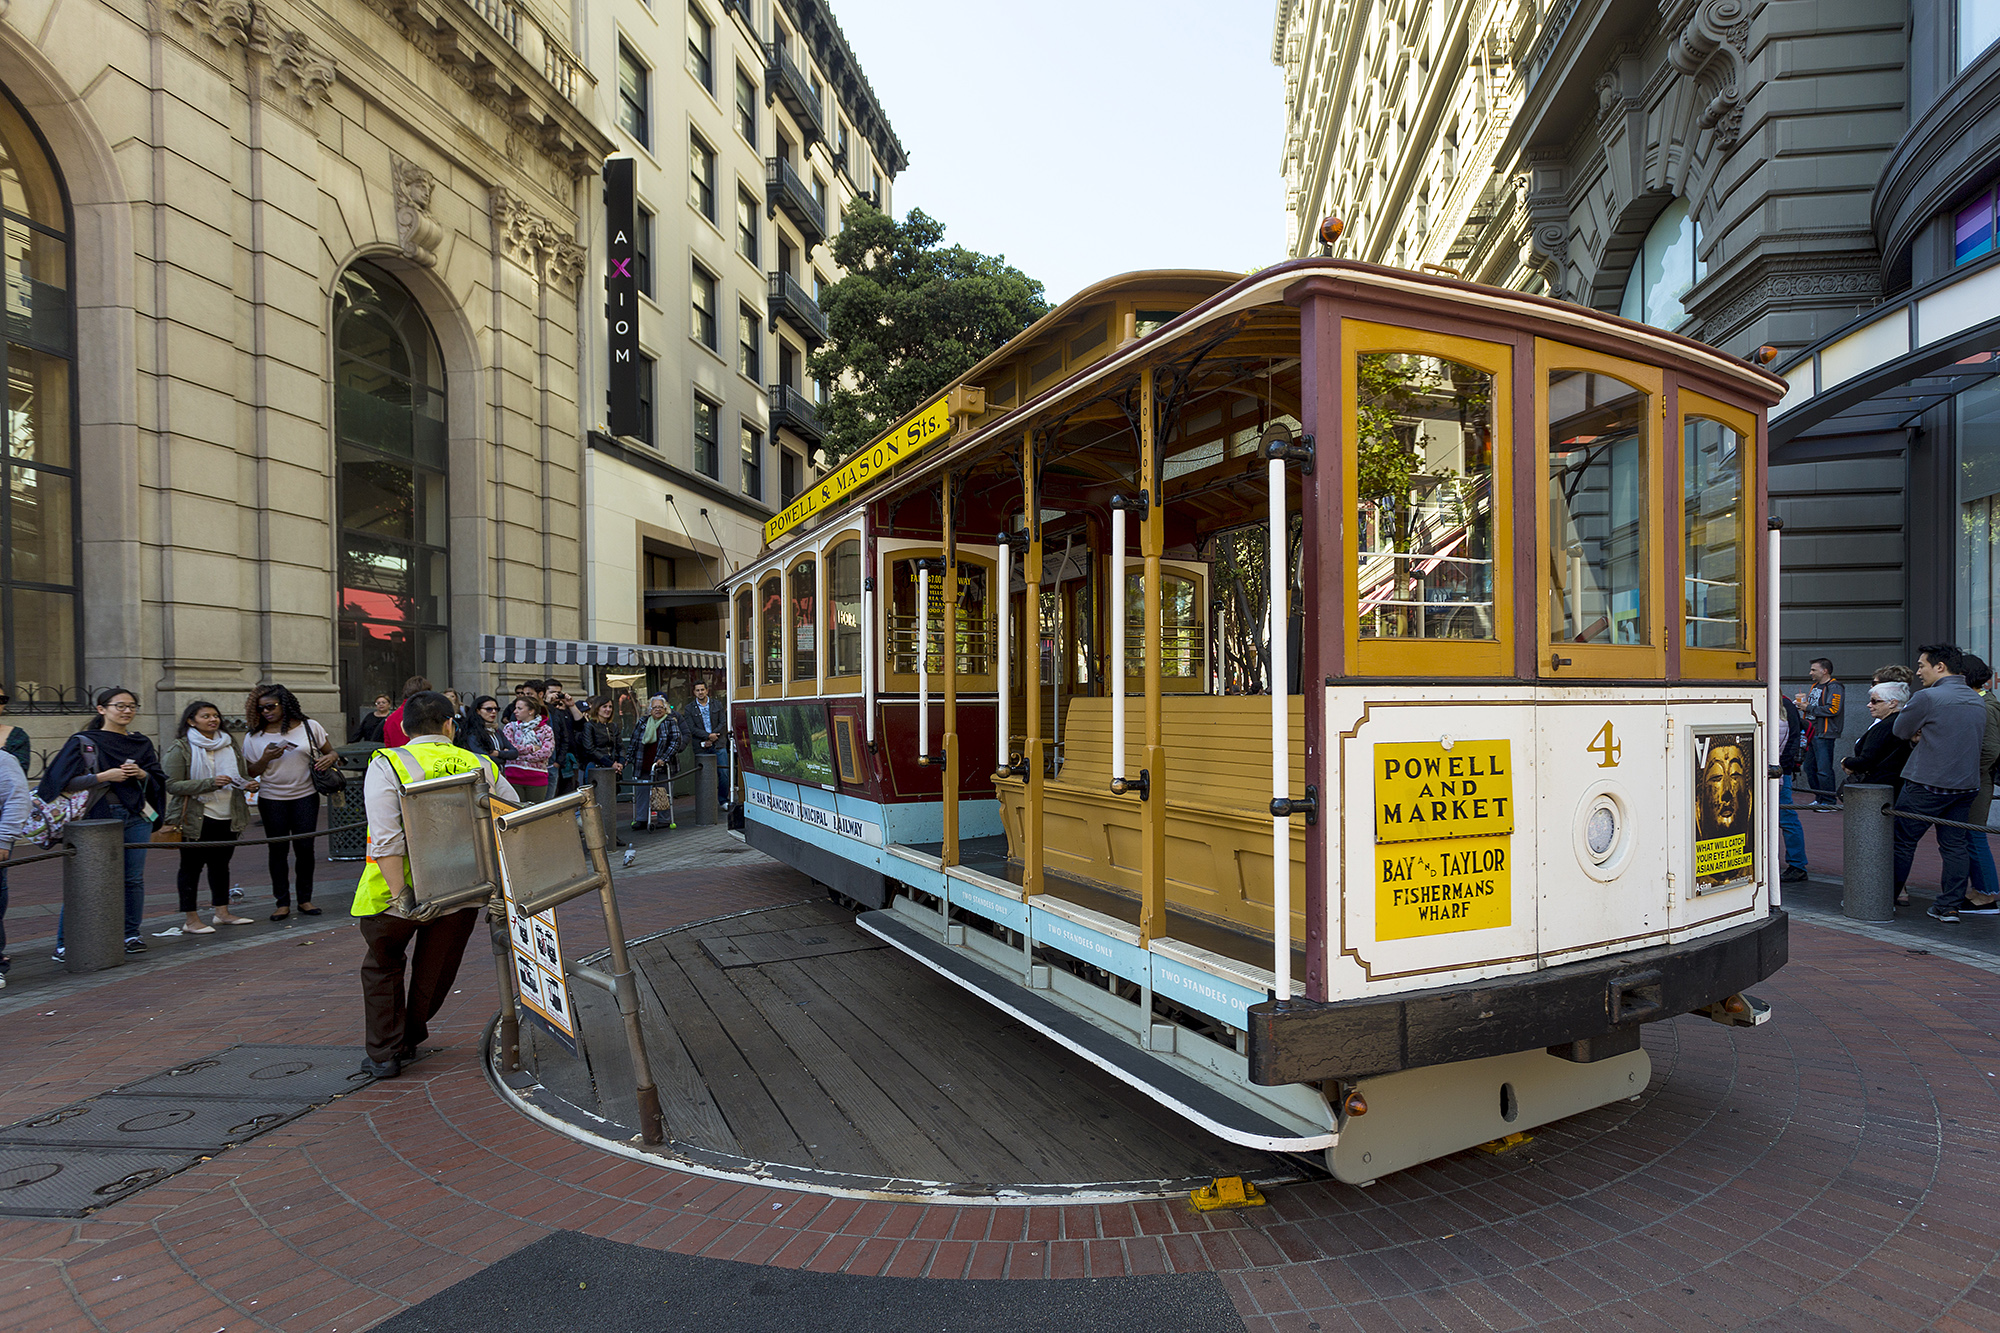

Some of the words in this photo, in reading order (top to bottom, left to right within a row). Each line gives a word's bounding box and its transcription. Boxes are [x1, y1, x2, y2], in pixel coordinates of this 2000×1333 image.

[610, 230, 632, 363] AXIOM
[770, 496, 817, 536] POWELL
[821, 485, 832, 504] &
[836, 435, 901, 494] MASON
[906, 415, 941, 448] Sts.
[751, 715, 778, 737] MONET
[1586, 719, 1622, 768] 4
[1384, 755, 1504, 780] POWELL
[756, 791, 766, 806] SAN
[1418, 780, 1478, 799] AND
[1383, 797, 1508, 825] MARKET
[1696, 842, 1714, 853] WHAT
[1714, 840, 1728, 850] WILL
[1729, 837, 1745, 848] CATCH
[1696, 852, 1712, 863] YOUR
[1713, 850, 1725, 861] EYE
[1726, 849, 1732, 857] AT
[1732, 847, 1742, 855] THE
[1382, 856, 1416, 883] BAY
[1418, 856, 1437, 878] AND
[1440, 848, 1505, 877] TAYLOR
[1696, 863, 1715, 874] ASIAN
[1715, 860, 1727, 870] ART
[1727, 855, 1751, 868] MUSEUM?
[962, 891, 972, 901] TWO
[972, 895, 995, 910] STANDEES
[994, 903, 1008, 915] ONLY
[1393, 880, 1494, 907] FISHERMANS
[1418, 901, 1471, 921] WHARF
[1048, 923, 1062, 936] TWO
[1063, 930, 1093, 950] STANDEES
[1095, 943, 1113, 958] ONLY
[1161, 968, 1181, 985] TWO
[1182, 977, 1228, 1005] STANDEES
[1230, 997, 1250, 1012] ON
